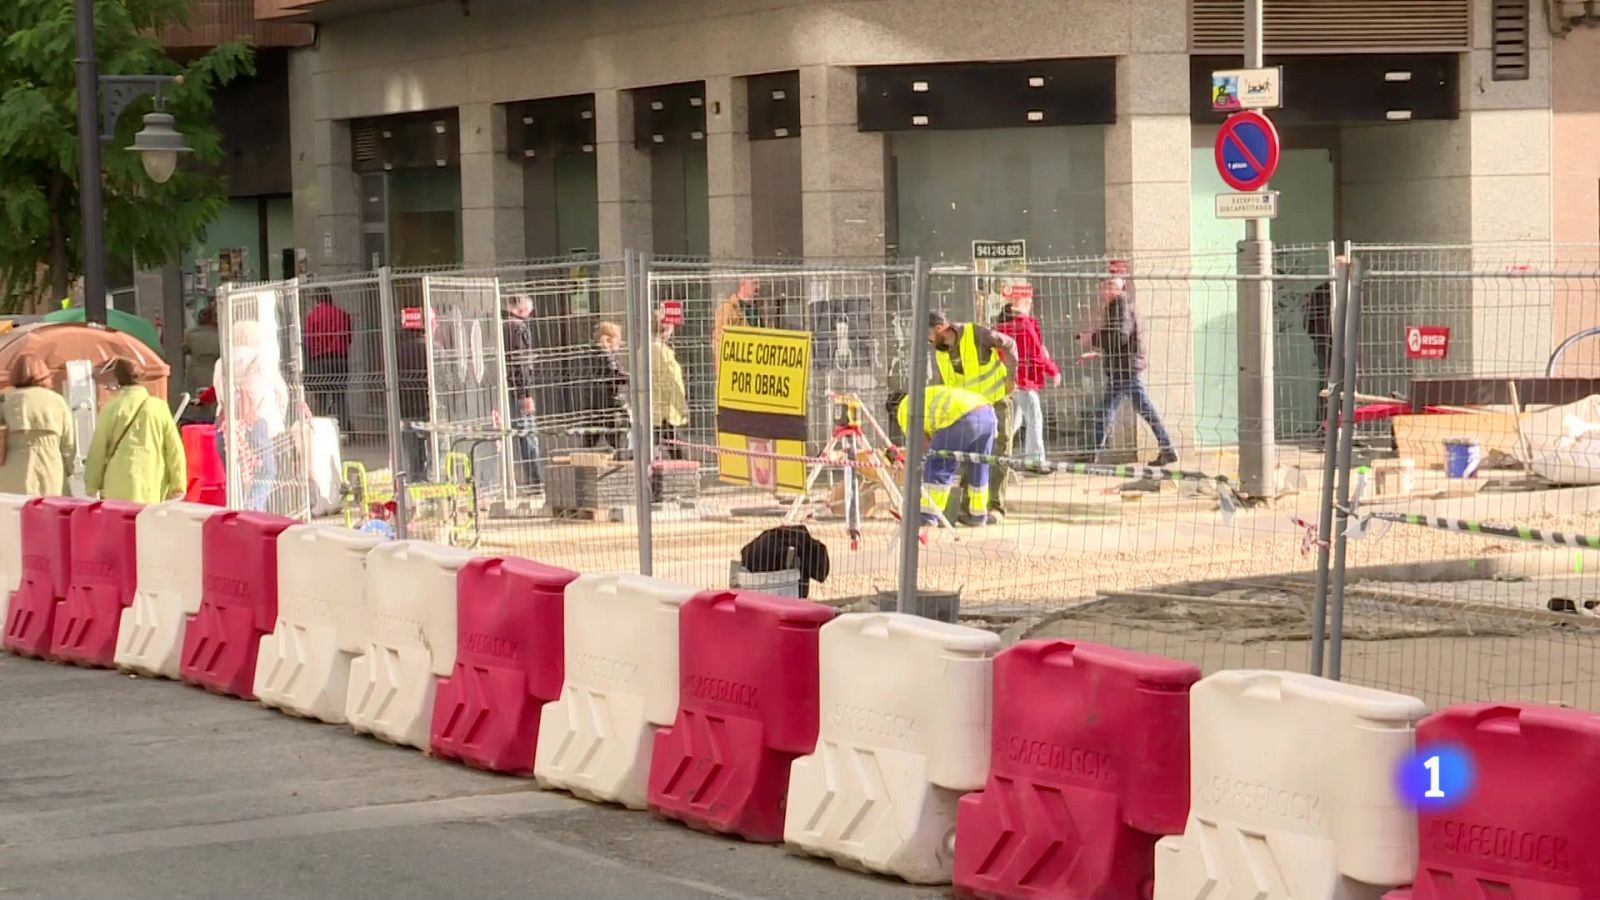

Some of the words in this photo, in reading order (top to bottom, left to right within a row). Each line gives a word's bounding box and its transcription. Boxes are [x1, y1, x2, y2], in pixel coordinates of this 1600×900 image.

[976, 245, 991, 256] 941
[991, 245, 1005, 257] 245
[1006, 244, 1021, 256] 622
[723, 340, 754, 364] CALLE
[755, 343, 803, 369] CORTADA
[731, 371, 752, 394] POR
[754, 373, 790, 398] OBRAS
[1008, 735, 1113, 782] SAFEBLOCK
[1211, 774, 1322, 826] SAFEBLOCK
[1443, 820, 1570, 872] SAFEBLOCK
